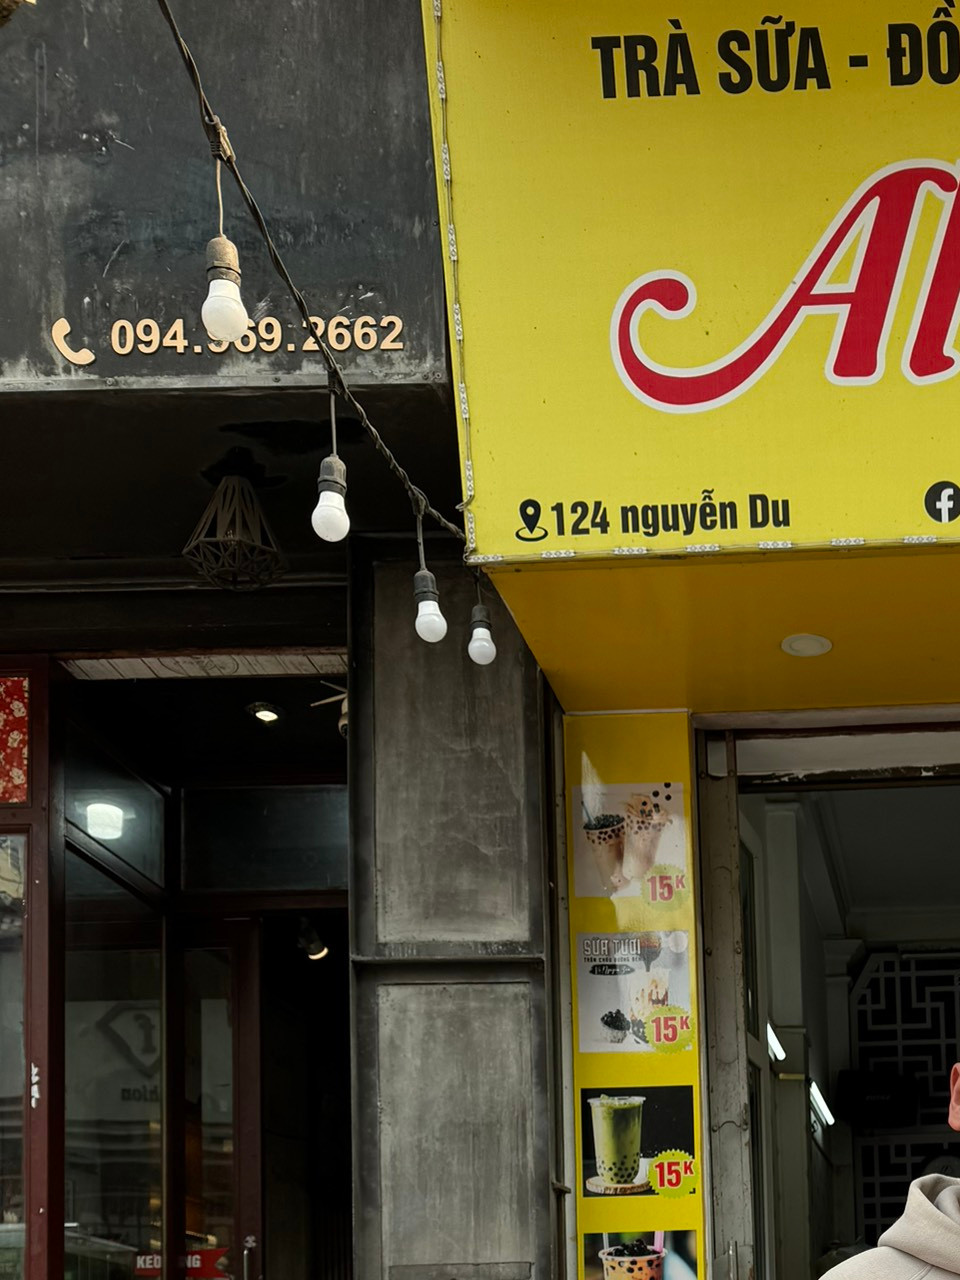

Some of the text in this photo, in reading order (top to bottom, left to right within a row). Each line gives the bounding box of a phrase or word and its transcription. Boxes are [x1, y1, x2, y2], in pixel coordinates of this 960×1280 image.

[591, 18, 701, 99] TRÀ
[717, 15, 831, 94] SỮA
[550, 488, 791, 538] 124 nguyễn Du
[647, 874, 686, 902] 15K
[651, 1015, 690, 1043] 15K
[654, 1160, 694, 1188] 15K
